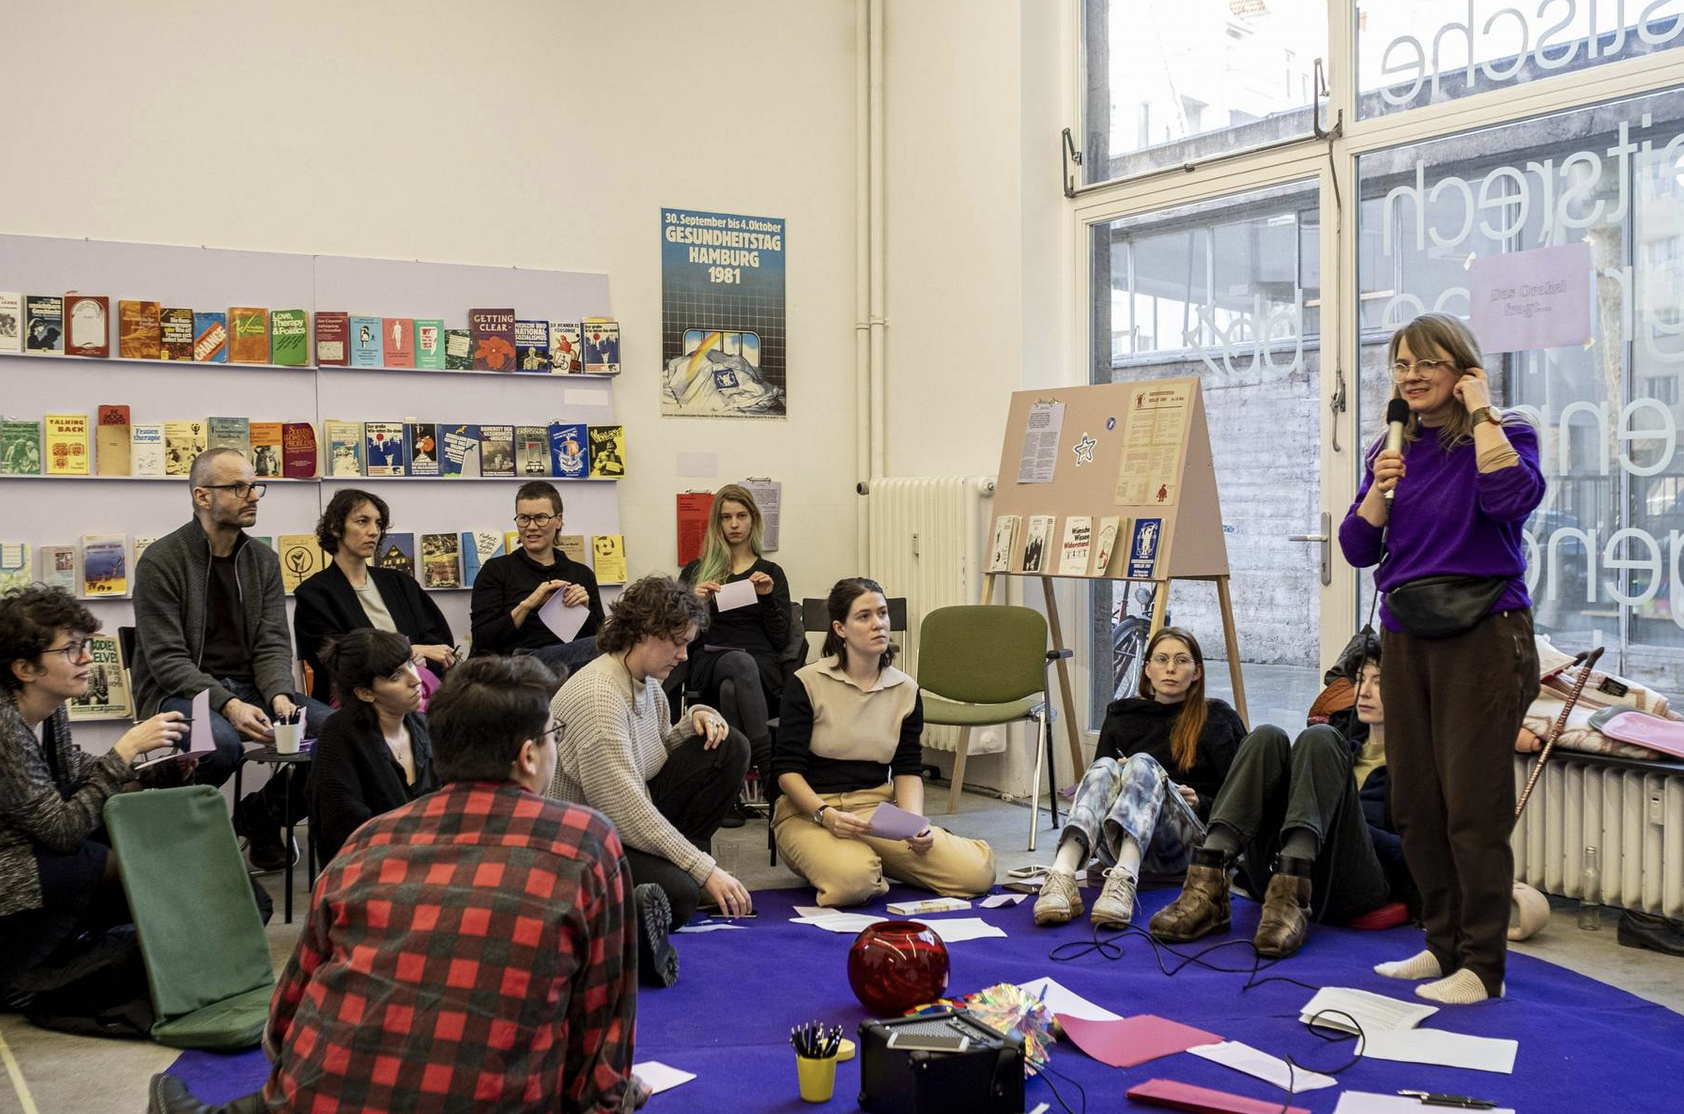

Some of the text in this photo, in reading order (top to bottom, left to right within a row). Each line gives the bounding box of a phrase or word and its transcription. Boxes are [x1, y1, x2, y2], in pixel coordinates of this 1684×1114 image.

[665, 213, 679, 224] 30.
[680, 214, 726, 228] September
[728, 218, 740, 229] bis
[748, 220, 782, 233] Oktober
[665, 226, 782, 251] GESUNDHEITSTAG
[689, 246, 760, 268] HAMBURG
[708, 266, 740, 284] 1981
[272, 320, 304, 328] Therapy
[474, 314, 514, 323] GETTING
[480, 324, 508, 332] CLEAR
[194, 324, 227, 361] CHANGE
